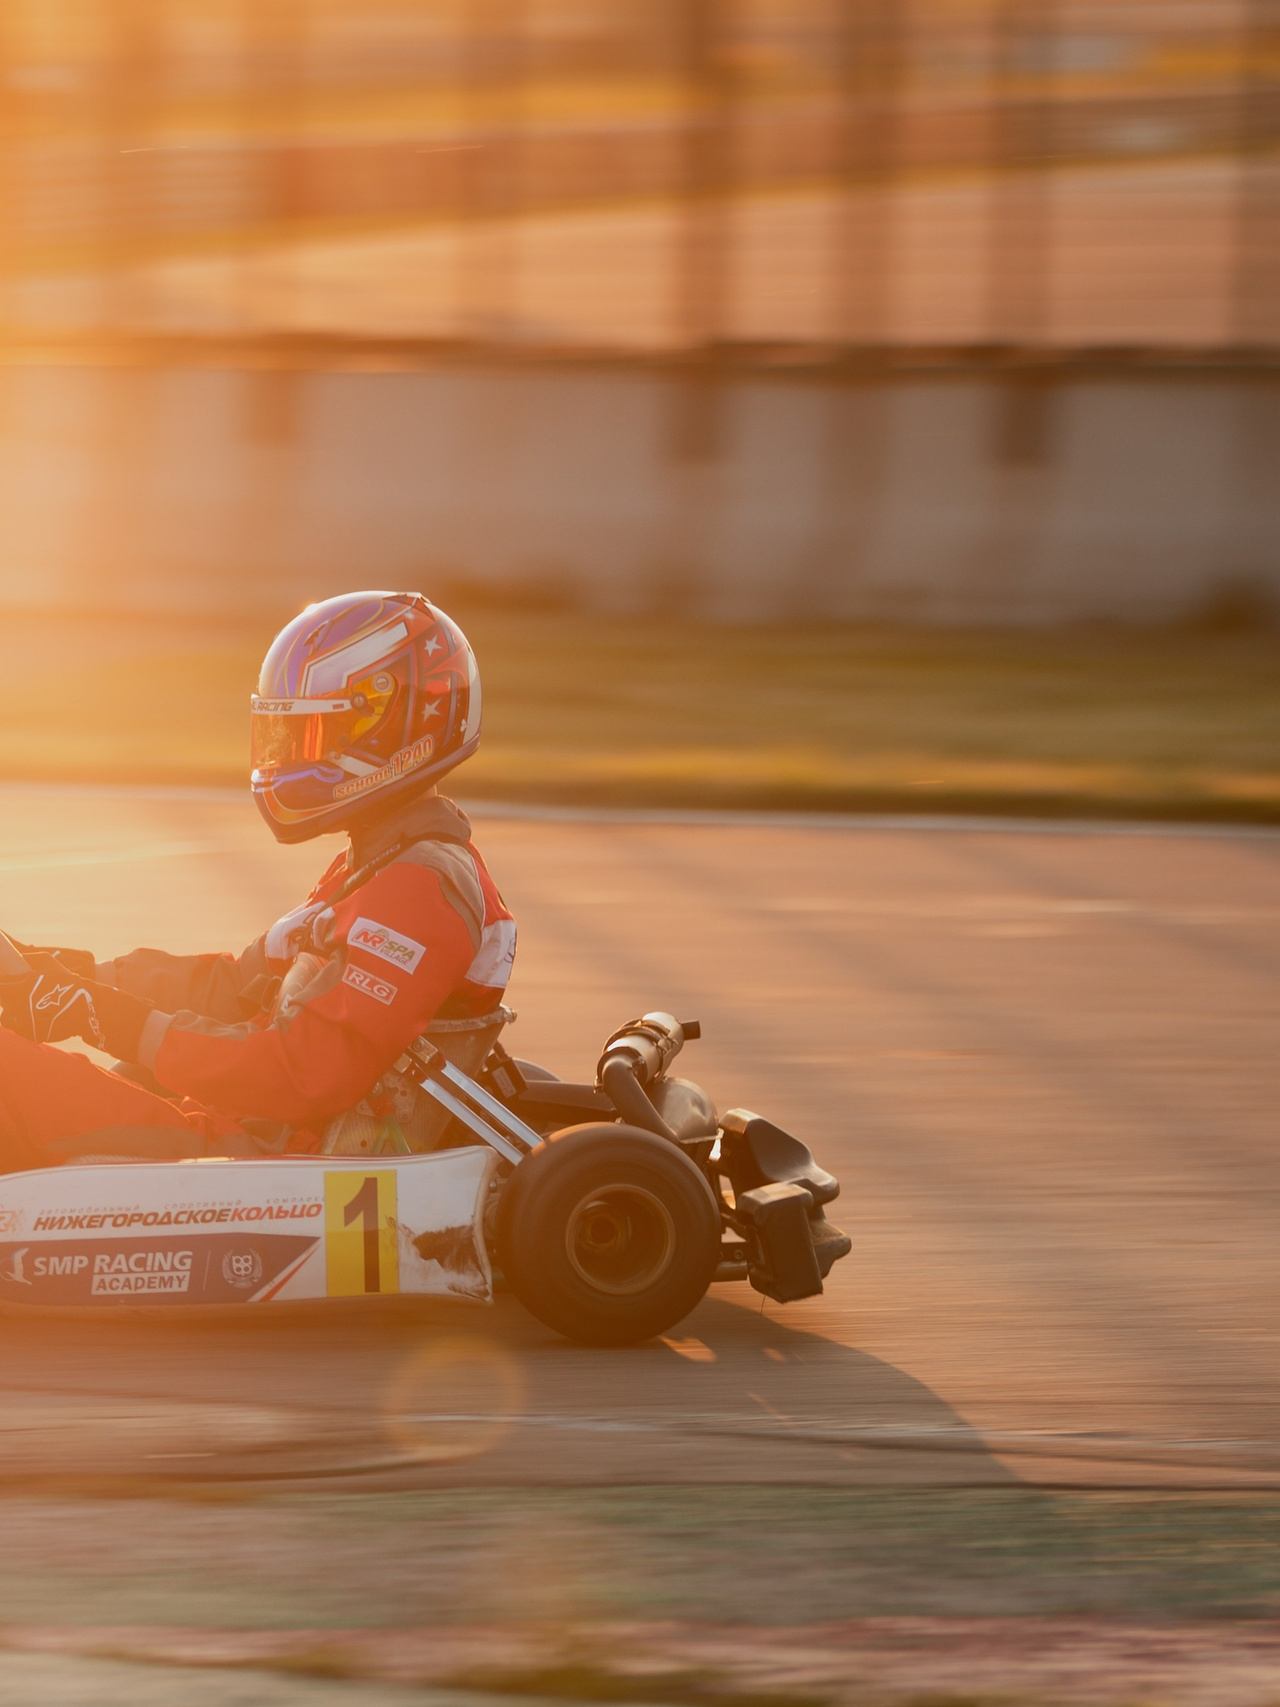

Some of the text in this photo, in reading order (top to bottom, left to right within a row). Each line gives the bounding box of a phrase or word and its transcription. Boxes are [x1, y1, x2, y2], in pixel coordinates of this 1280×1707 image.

[257, 701, 295, 712] RACING
[335, 737, 434, 798] SCHOOL 1240
[354, 930, 416, 960] NR SPA
[380, 948, 410, 965] VILLAGE
[348, 971, 390, 998] RLG
[343, 1177, 380, 1293] 1
[33, 1251, 193, 1276] SMP RACING
[96, 1275, 186, 1292] ACADEMY
